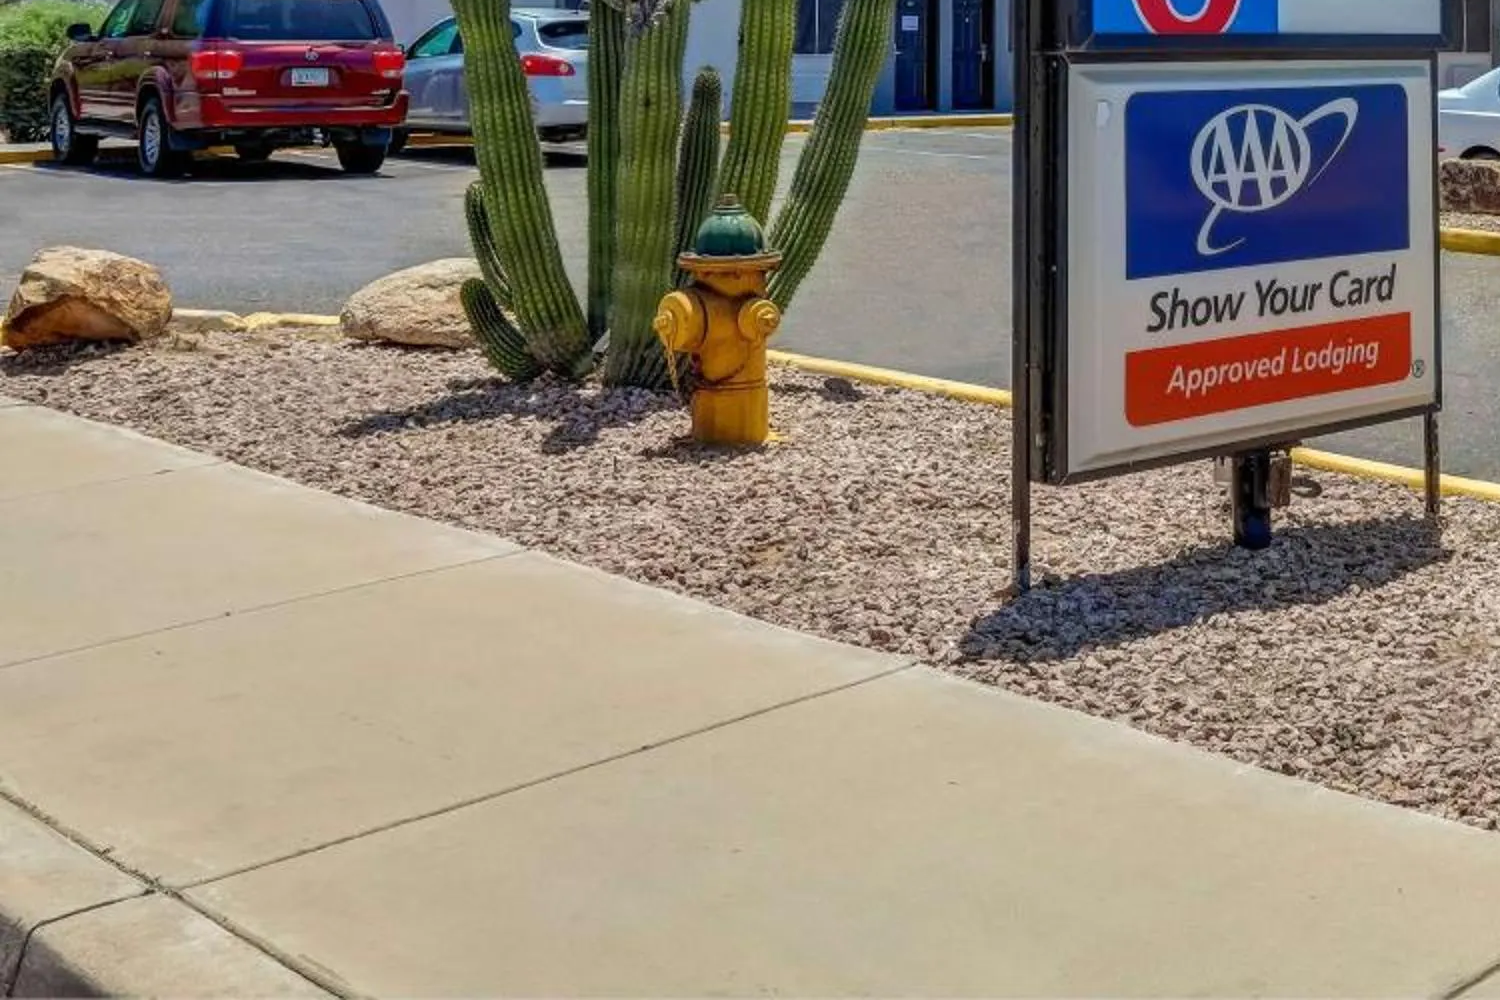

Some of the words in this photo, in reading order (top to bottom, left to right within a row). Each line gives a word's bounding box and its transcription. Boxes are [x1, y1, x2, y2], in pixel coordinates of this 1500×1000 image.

[1203, 106, 1302, 209] AAA
[1146, 287, 1246, 333] Show
[1254, 278, 1322, 317] Your
[1329, 263, 1397, 308] Card
[1166, 347, 1287, 398] Approved
[1292, 338, 1379, 375] Lodging
